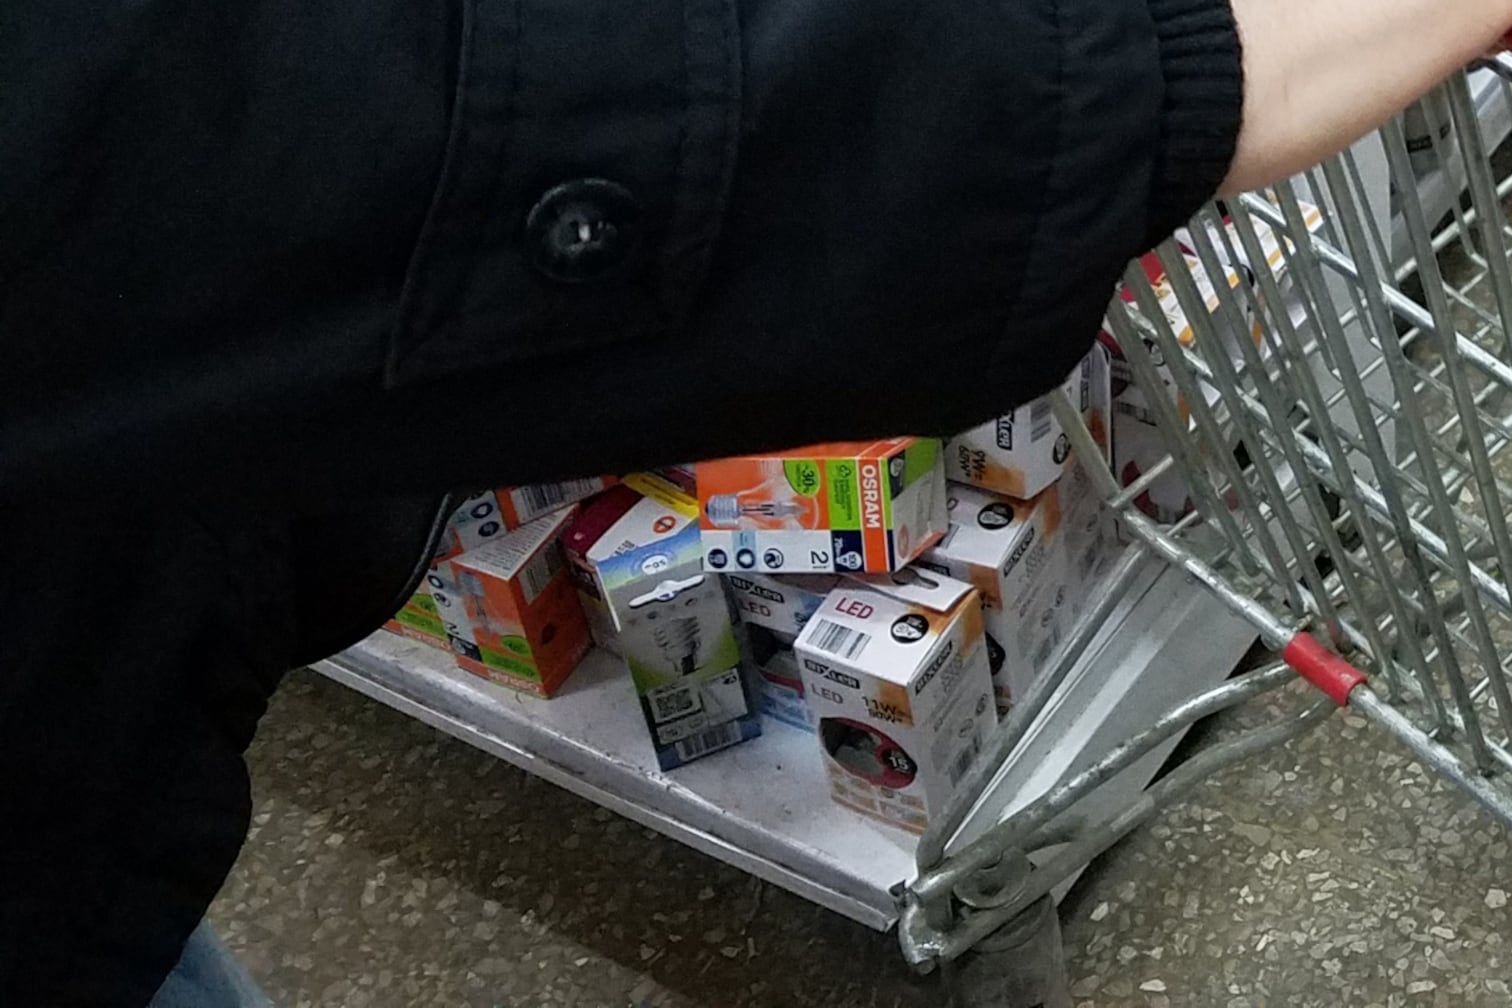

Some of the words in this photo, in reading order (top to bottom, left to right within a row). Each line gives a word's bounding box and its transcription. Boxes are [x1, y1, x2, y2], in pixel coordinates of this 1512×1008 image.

[861, 463, 882, 529] OSRAM
[834, 596, 875, 621] LED
[810, 682, 844, 706] LED
